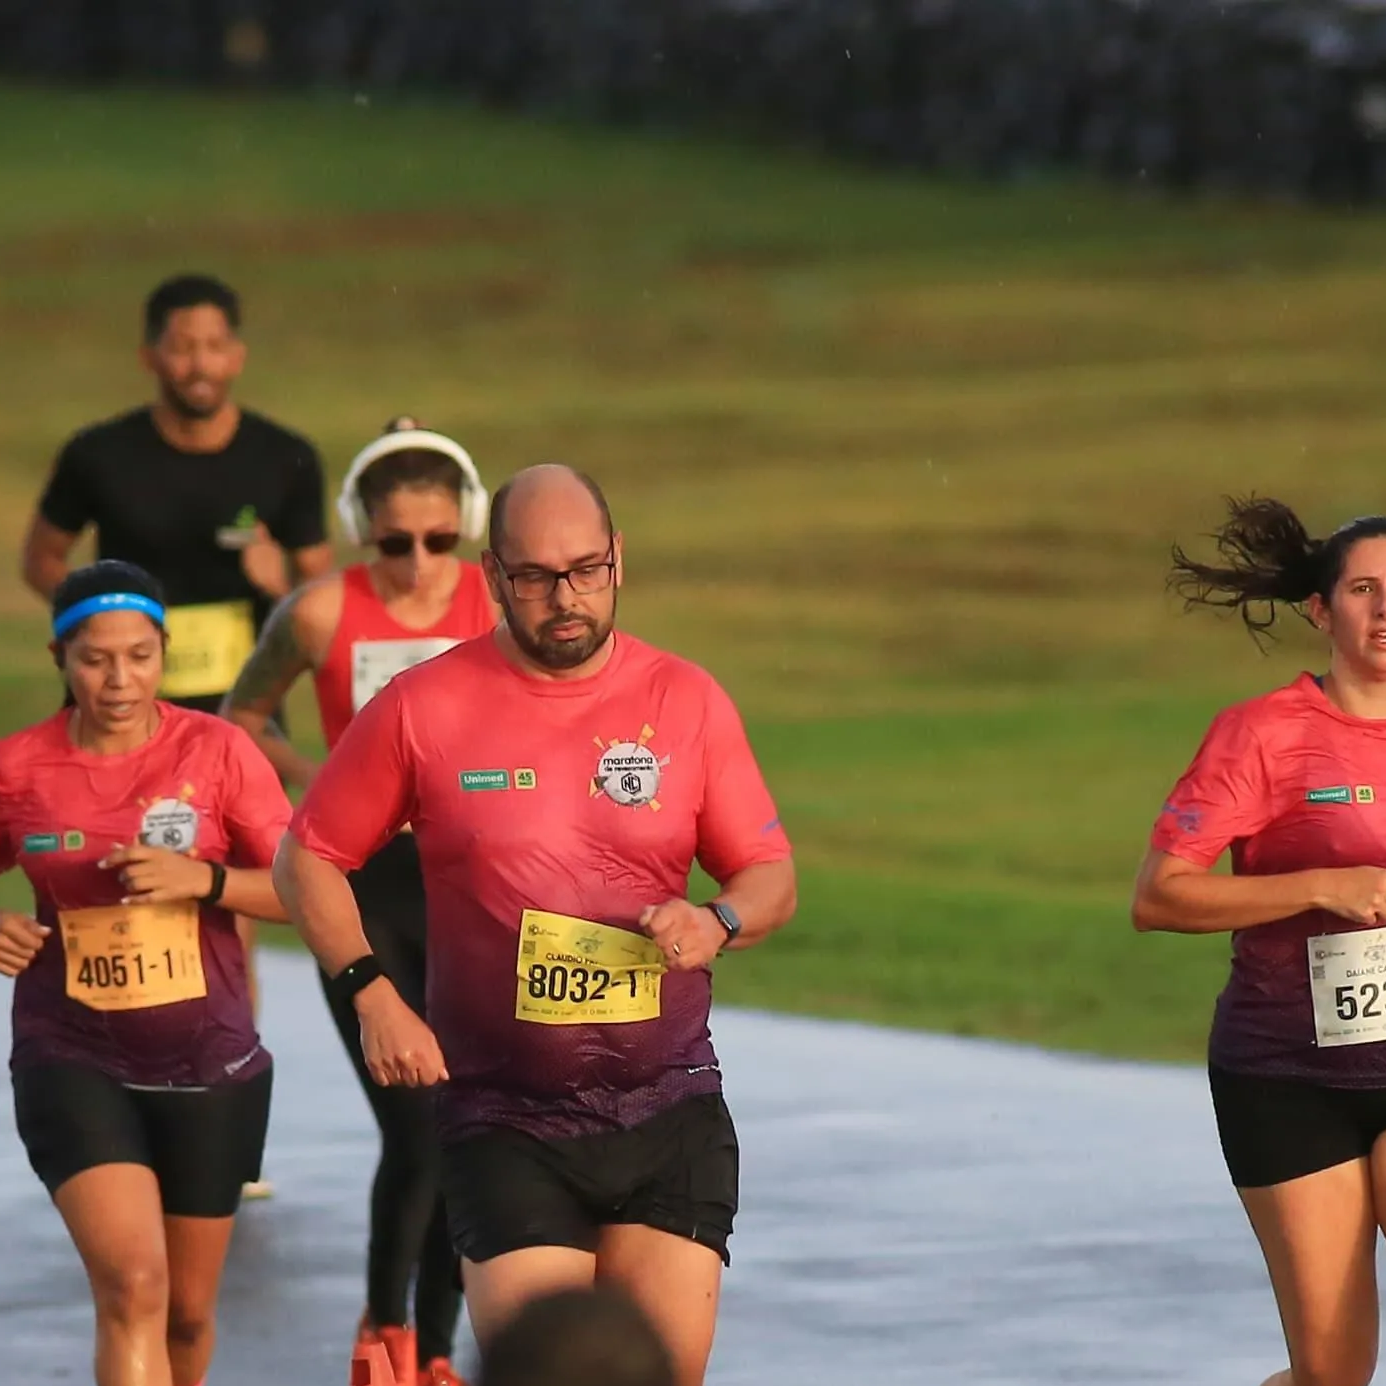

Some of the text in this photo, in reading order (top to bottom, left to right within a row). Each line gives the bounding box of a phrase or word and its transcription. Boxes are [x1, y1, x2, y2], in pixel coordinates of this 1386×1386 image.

[603, 756, 653, 766] maratona
[463, 774, 504, 785] Unimed
[518, 772, 532, 781] 45
[77, 948, 173, 988] 4051-1
[528, 964, 636, 1003] 8032-1
